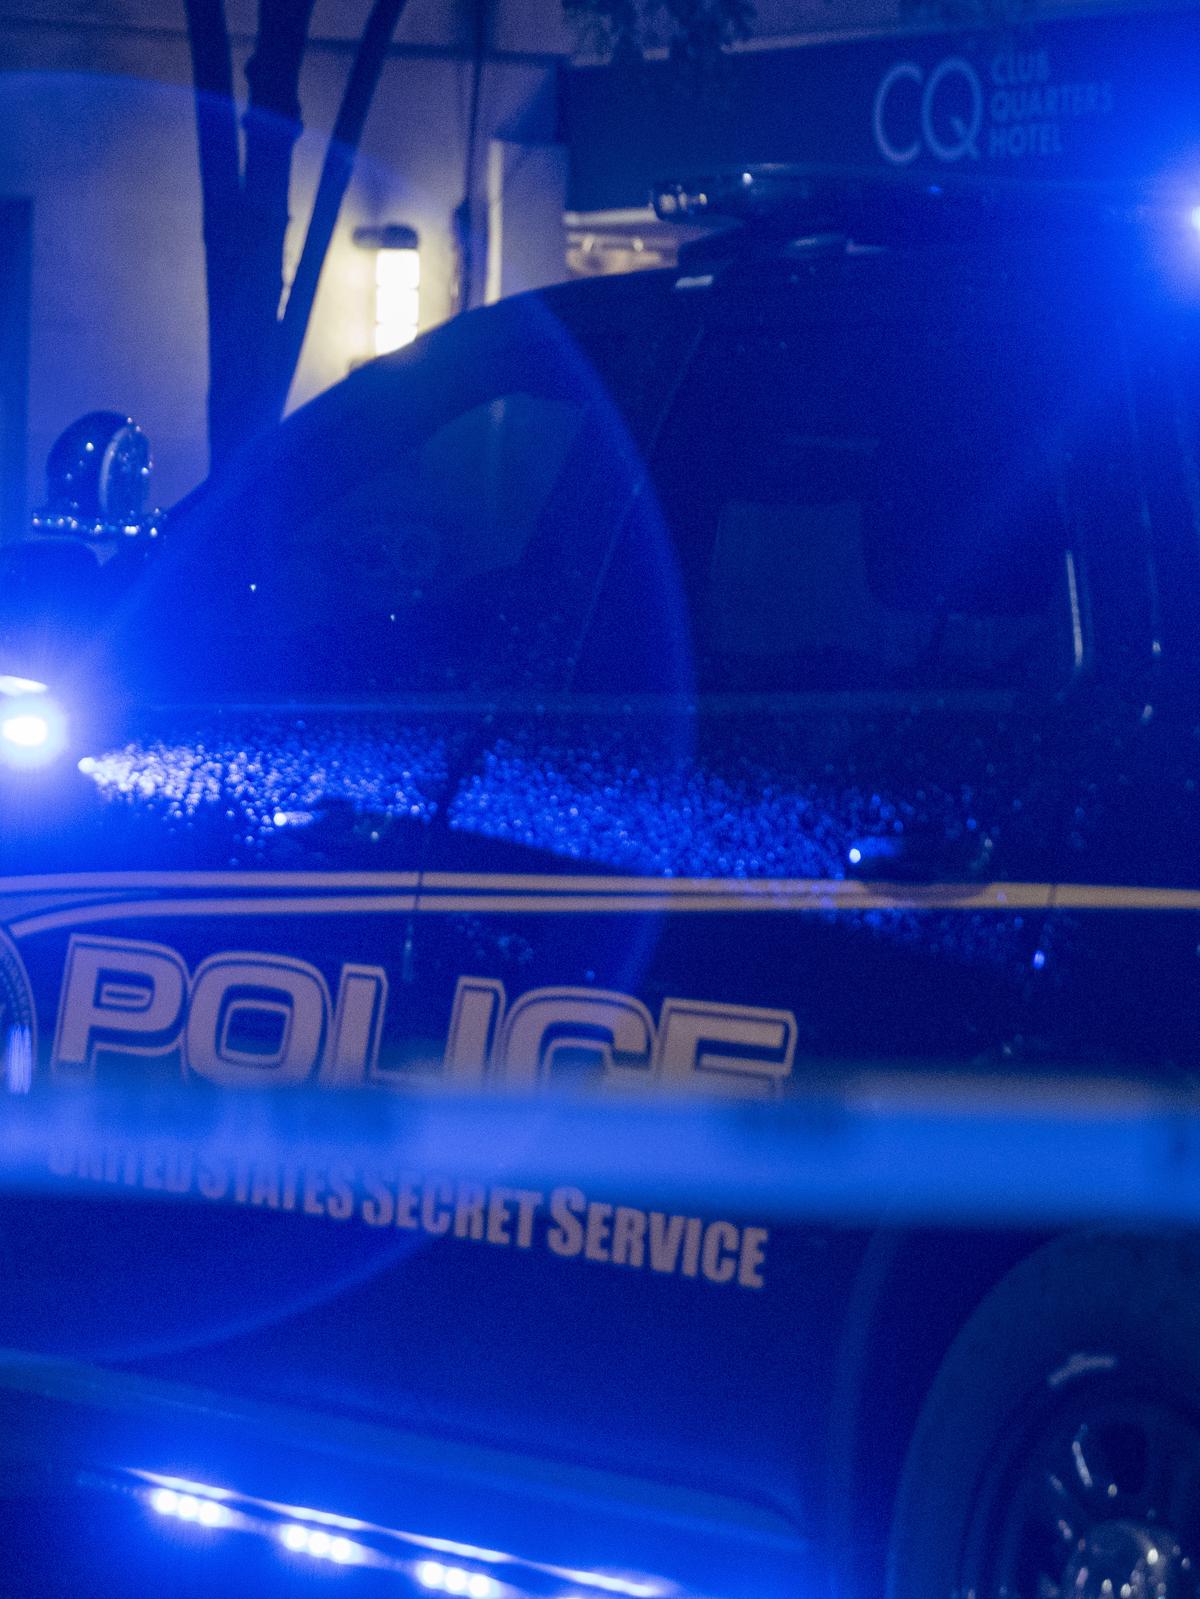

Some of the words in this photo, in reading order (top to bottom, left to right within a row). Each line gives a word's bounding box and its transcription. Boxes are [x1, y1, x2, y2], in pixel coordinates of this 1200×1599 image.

[990, 80, 1114, 122] QUARTERS
[991, 51, 1050, 83] CLUB
[873, 56, 983, 163] CQ
[989, 122, 1063, 157] HOTEL
[52, 932, 798, 1102] POLICE
[197, 1142, 355, 1219] STATES
[362, 1164, 543, 1249] SECRET
[547, 1185, 770, 1289] SERVICE
